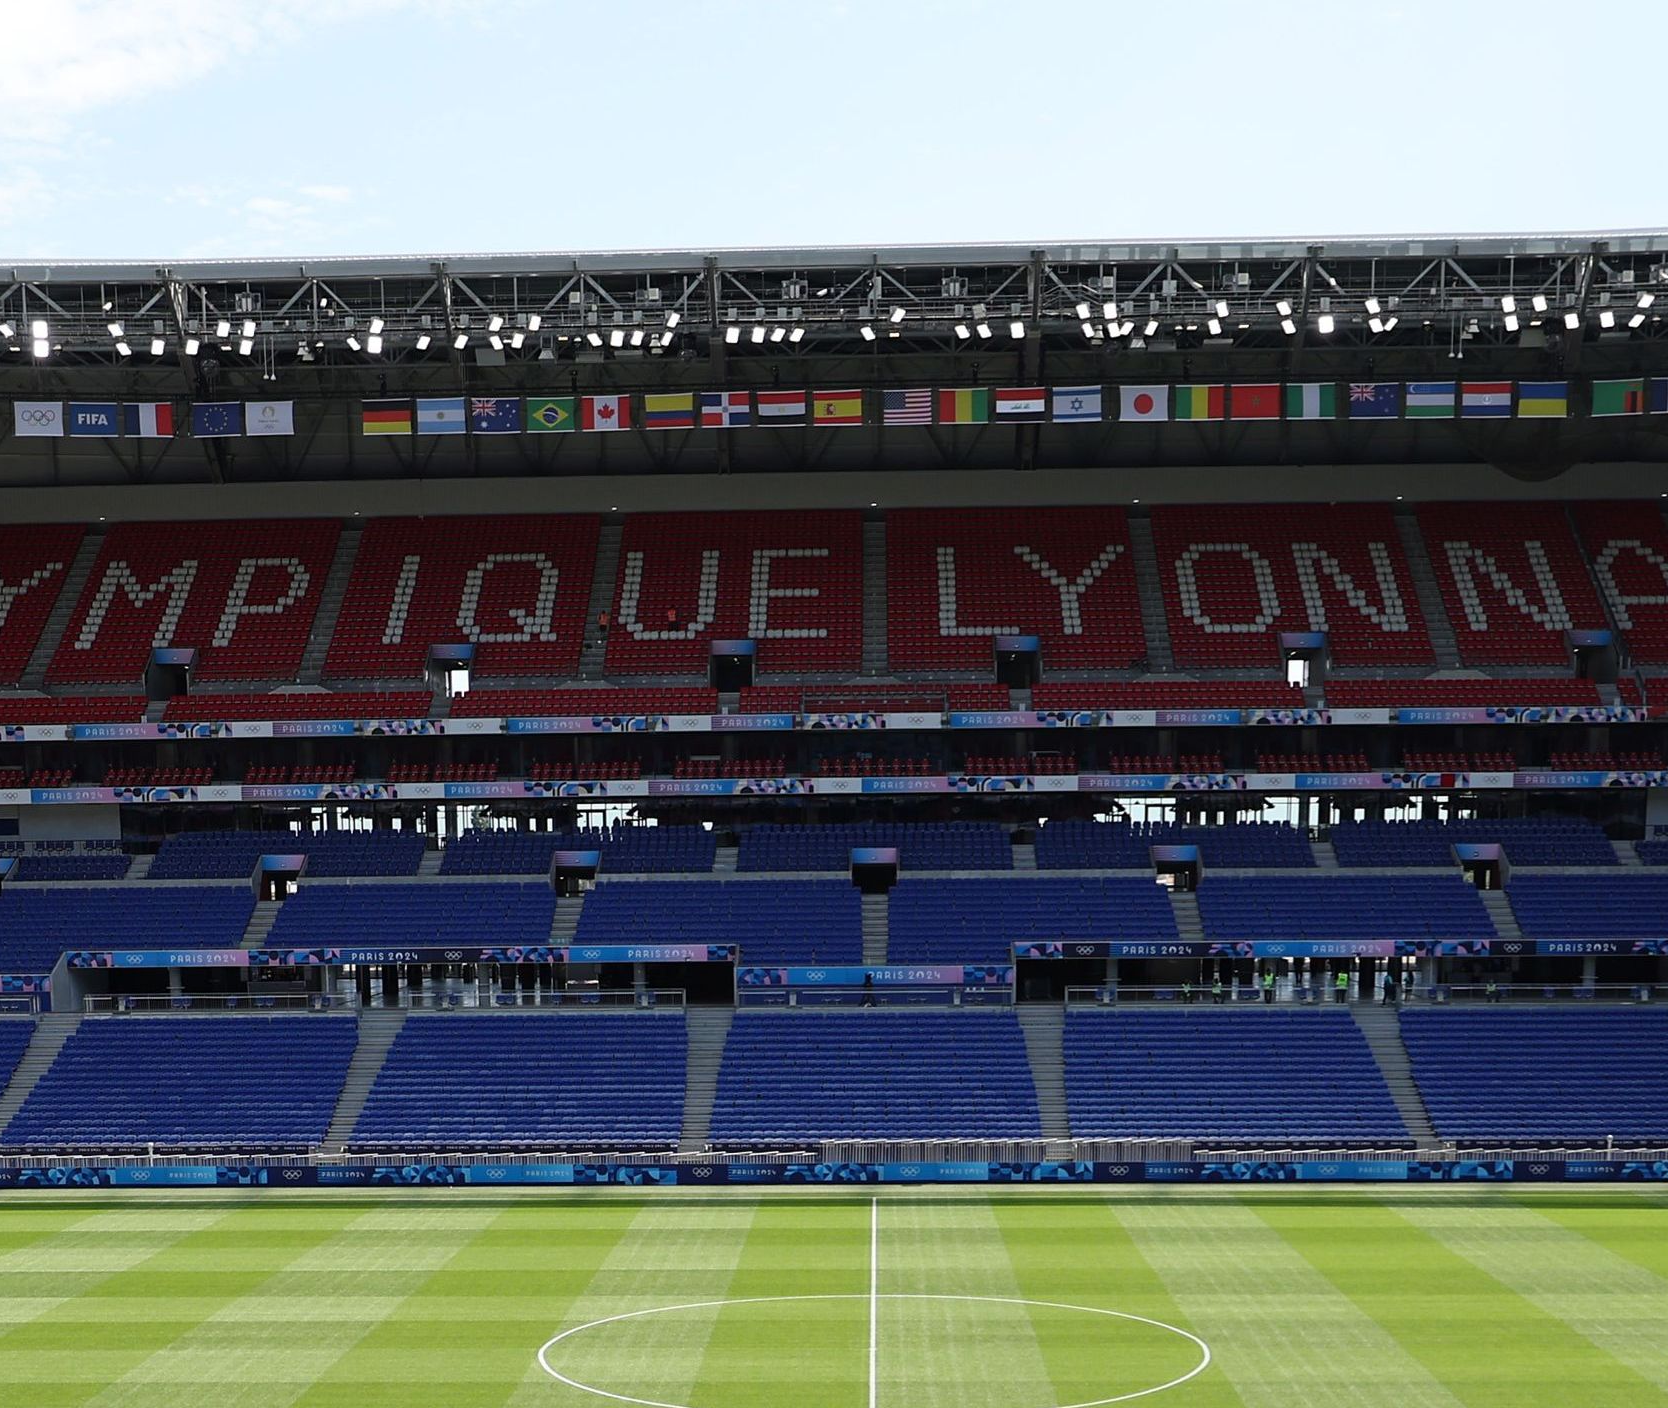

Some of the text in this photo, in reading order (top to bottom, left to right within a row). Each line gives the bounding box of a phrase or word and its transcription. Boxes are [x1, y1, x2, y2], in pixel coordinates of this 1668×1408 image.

[77, 413, 109, 426] FIFA
[996, 716, 1026, 724] 2024
[1199, 713, 1230, 722] 2024
[1444, 712, 1475, 720] 2024
[551, 721, 581, 729] 2024
[755, 718, 785, 727] 2024
[118, 728, 147, 736] 2024
[316, 723, 345, 733] 2024
[1124, 778, 1154, 787] 2024
[1341, 776, 1371, 785] 2024
[1559, 775, 1589, 784] 2024
[484, 785, 513, 793] 2024
[693, 783, 723, 792] 2024
[907, 781, 936, 789] 2024
[75, 791, 103, 799] 2024
[286, 787, 315, 796] 2024
[1122, 945, 1192, 954] PARIS 2024
[1312, 944, 1382, 953] PARIS 2024
[1549, 943, 1617, 953] PARIS 2024
[351, 952, 418, 961] PARIS 2024
[627, 949, 695, 958] PARIS 2024
[170, 954, 237, 963] PARIS 2024
[869, 970, 941, 979] PARIS 2024
